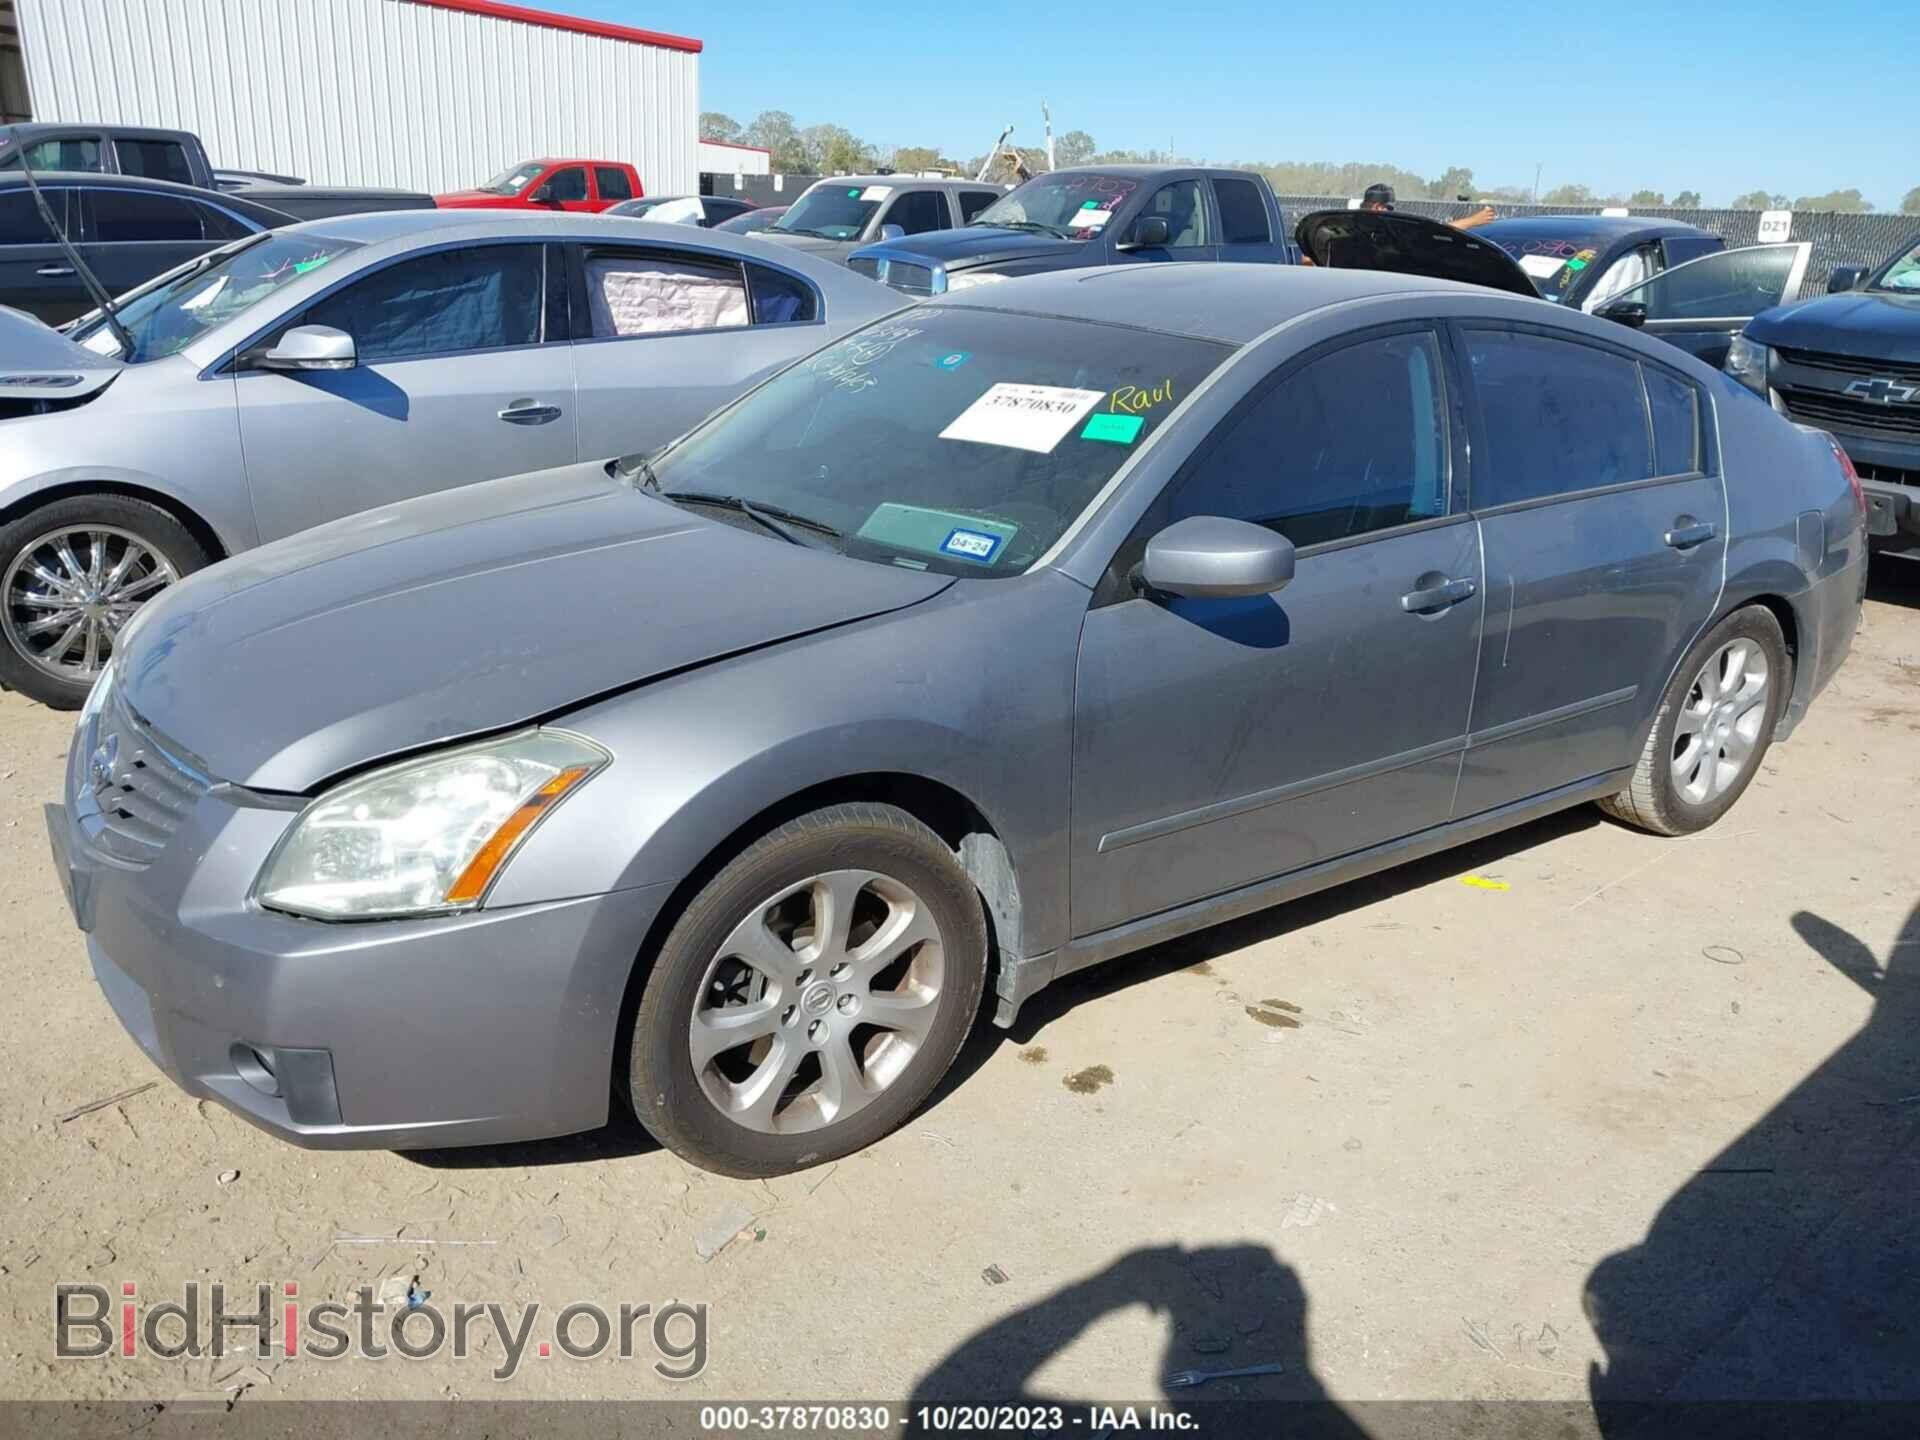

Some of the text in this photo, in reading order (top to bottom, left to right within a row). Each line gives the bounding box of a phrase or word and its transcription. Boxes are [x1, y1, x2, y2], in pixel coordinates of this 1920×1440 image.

[986, 394, 1077, 415] 37870830
[1110, 380, 1173, 413] Raul
[951, 537, 988, 553] 04-24
